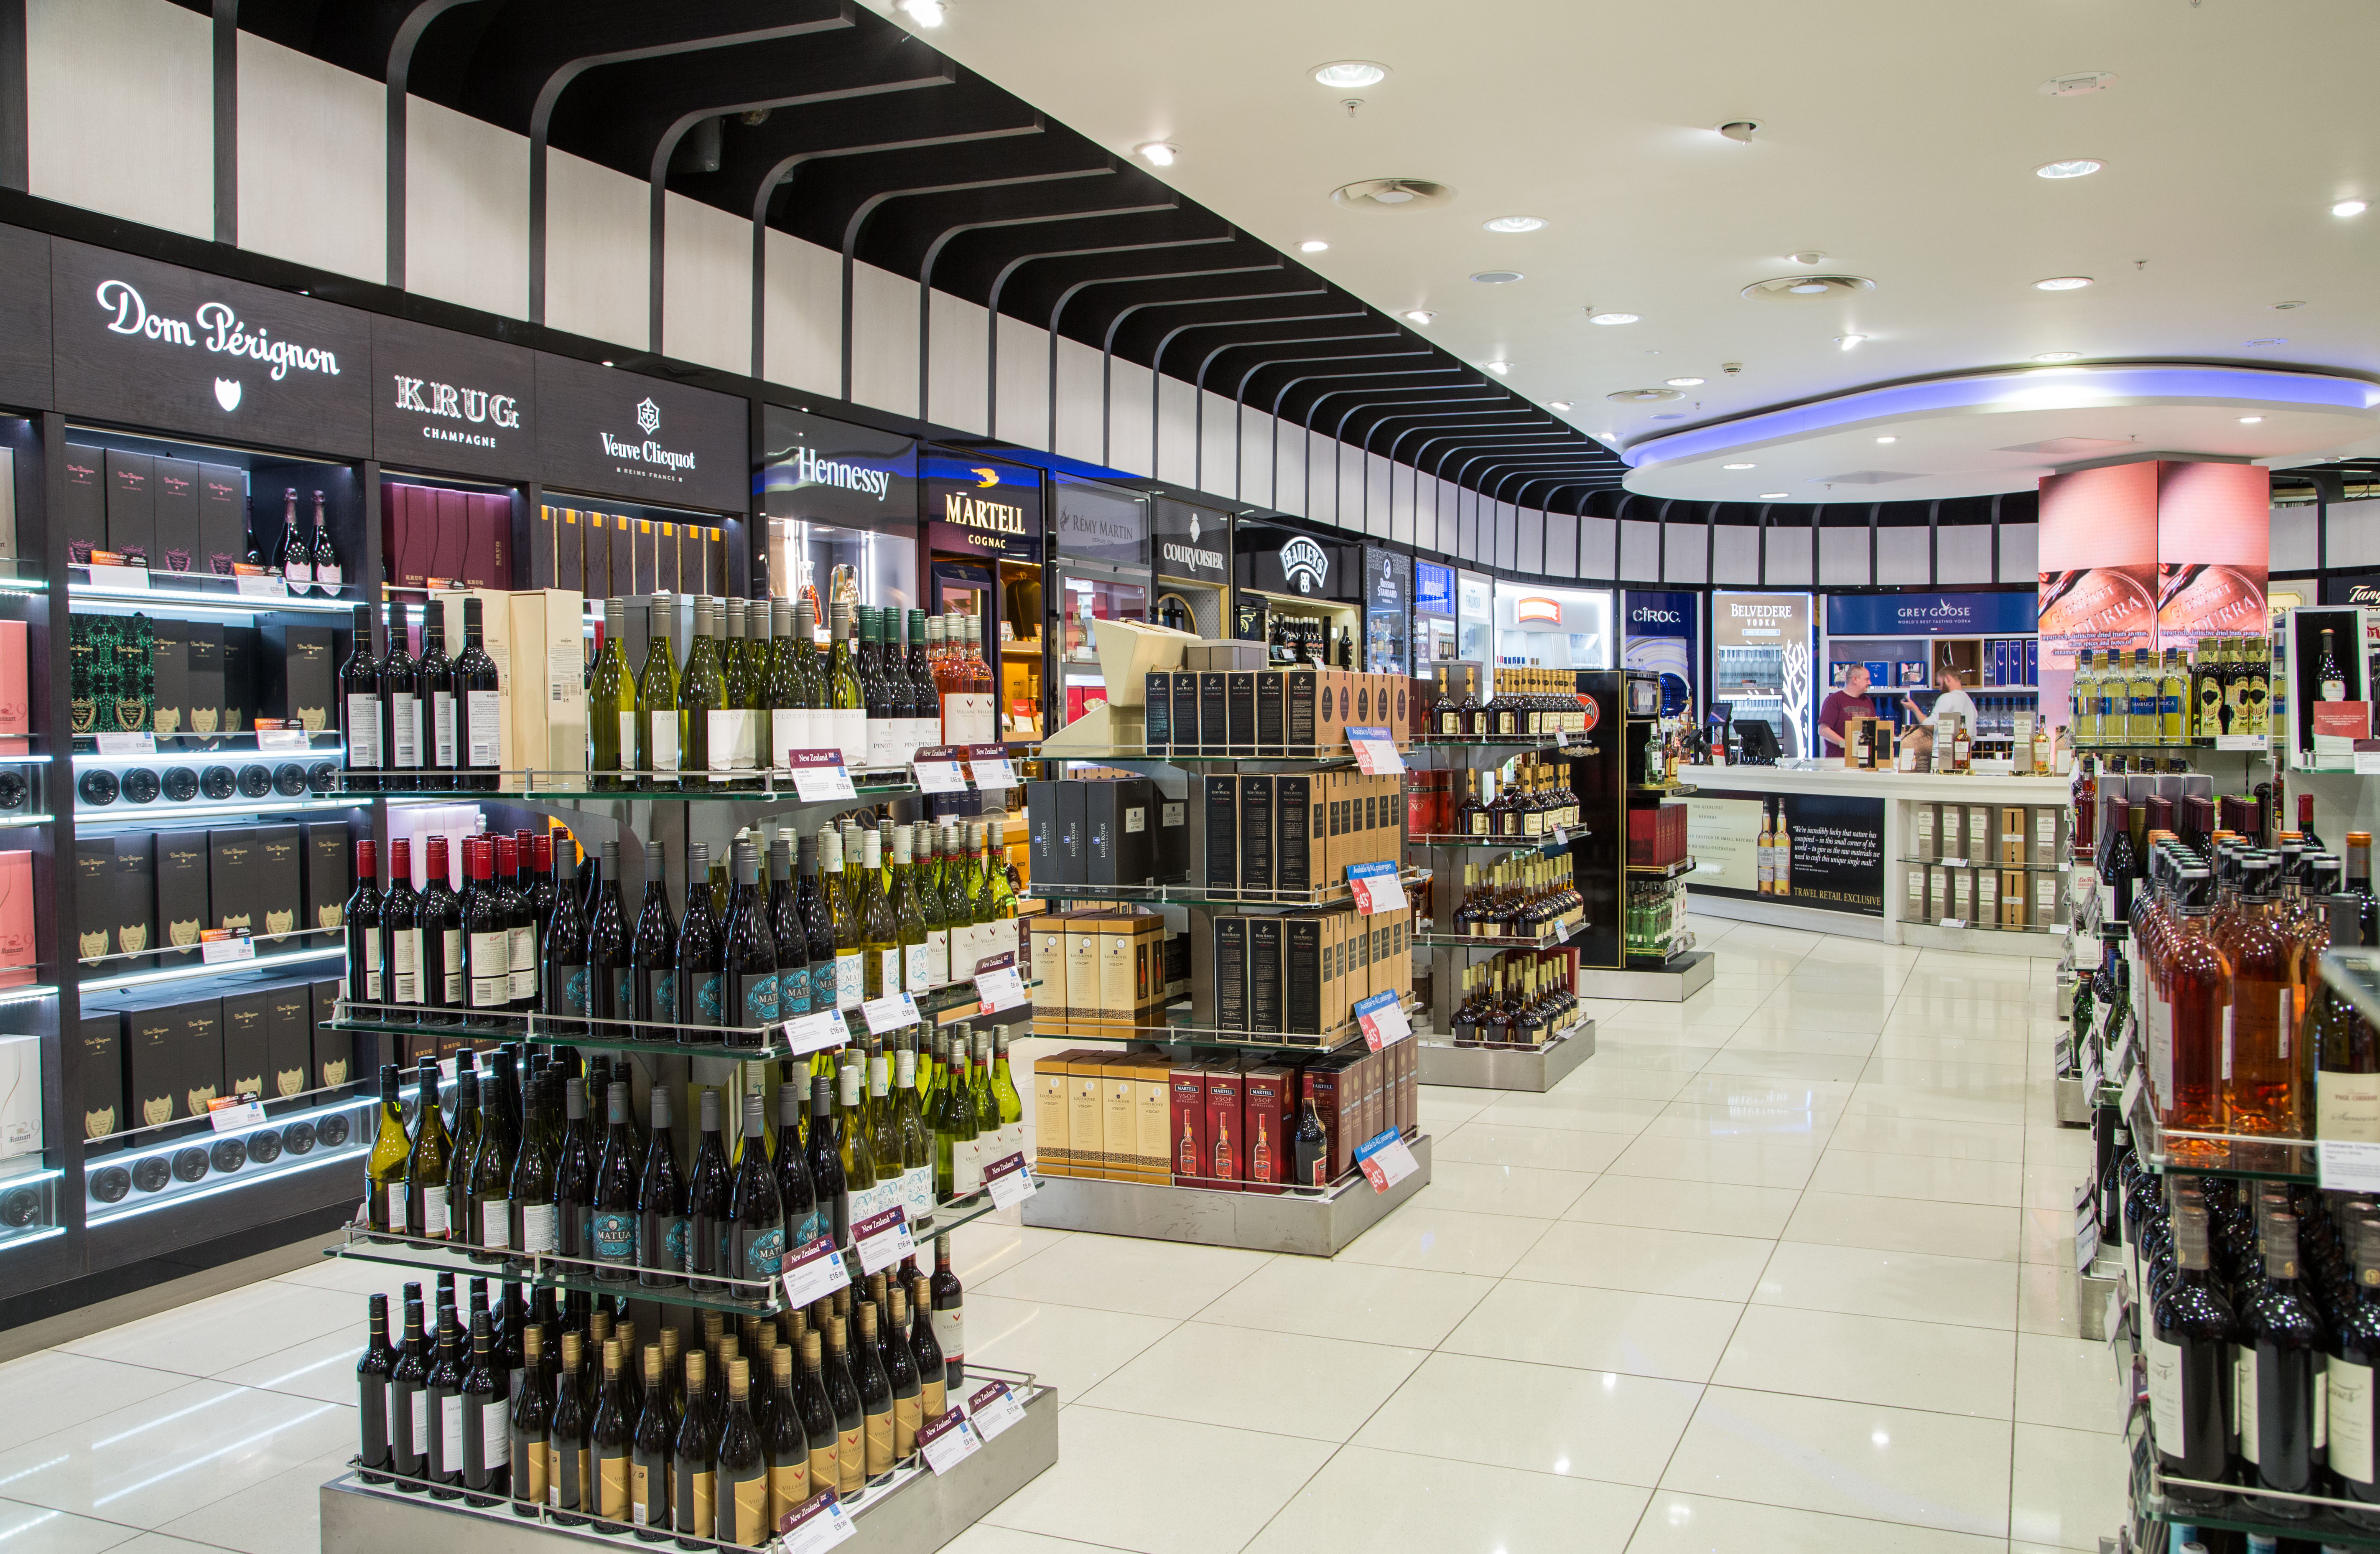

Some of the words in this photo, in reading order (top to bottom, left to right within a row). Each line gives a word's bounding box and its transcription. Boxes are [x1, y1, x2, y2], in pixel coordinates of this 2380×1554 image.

[97, 280, 196, 347] Dom
[196, 302, 340, 381] Pérignon
[394, 374, 520, 429] KRUG
[423, 427, 496, 448] CHAMPAGNE
[600, 432, 640, 460] Veuve
[642, 440, 696, 471] Clicquot
[624, 468, 646, 477] REIMS
[649, 471, 676, 481] FRANCE
[798, 446, 890, 501] Hennessy
[945, 493, 1026, 535] MARTELL
[1073, 514, 1097, 534] RÉMY
[1099, 519, 1133, 540] MARTIN
[968, 534, 1007, 549] COGNAC
[1163, 542, 1224, 572] COURVOISIER
[1285, 543, 1324, 574] BAILEYS
[1380, 577, 1395, 590] RUSSIAN
[1377, 585, 1397, 599] STANDARD
[1465, 595, 1480, 608] FINLANDIA
[1730, 603, 1792, 619] BELVEDERE
[1898, 608, 1925, 617] GREY
[1929, 607, 1970, 617] GOOSE
[810, 753, 828, 762] Zealand
[1358, 754, 1373, 768] £105
[1807, 826, 1829, 835] incredibly
[1830, 827, 1842, 836] lucky
[1868, 830, 1877, 839] has
[1794, 836, 1814, 844] conspired
[1862, 839, 1869, 849] of
[1817, 845, 1826, 854] give
[1810, 854, 1821, 863] craft
[1830, 856, 1847, 866] unique
[1847, 857, 1860, 867] single
[1353, 865, 1367, 874] Available
[1376, 863, 1392, 872] passengers
[1794, 887, 1818, 898] TRAVEL
[1819, 890, 1842, 901] RETAIL
[1844, 893, 1881, 906] EXCLUSIVE
[830, 1026, 845, 1035] £16.99
[9, 1132, 31, 1144] Ruinart
[1361, 1142, 1373, 1154] Available
[1380, 1129, 1395, 1143] passengers
[992, 1166, 1001, 1175] New
[1001, 1159, 1014, 1172] Zealand
[861, 1222, 873, 1233] New
[873, 1215, 890, 1229] Zealand
[597, 1230, 632, 1240] MATUA
[897, 1239, 911, 1250] £16.99
[791, 1252, 803, 1264] New
[803, 1244, 821, 1259] Zealand
[829, 1270, 844, 1281] £16.99
[973, 1396, 983, 1406] New
[981, 1386, 996, 1402] Zealand
[1007, 1404, 1019, 1415] £11.99
[925, 1427, 938, 1438] New
[936, 1416, 952, 1432] Zealand
[963, 1437, 974, 1447] £9.99
[790, 1511, 803, 1525] New
[802, 1498, 821, 1518] Zealand
[834, 1519, 847, 1531] £9.99
